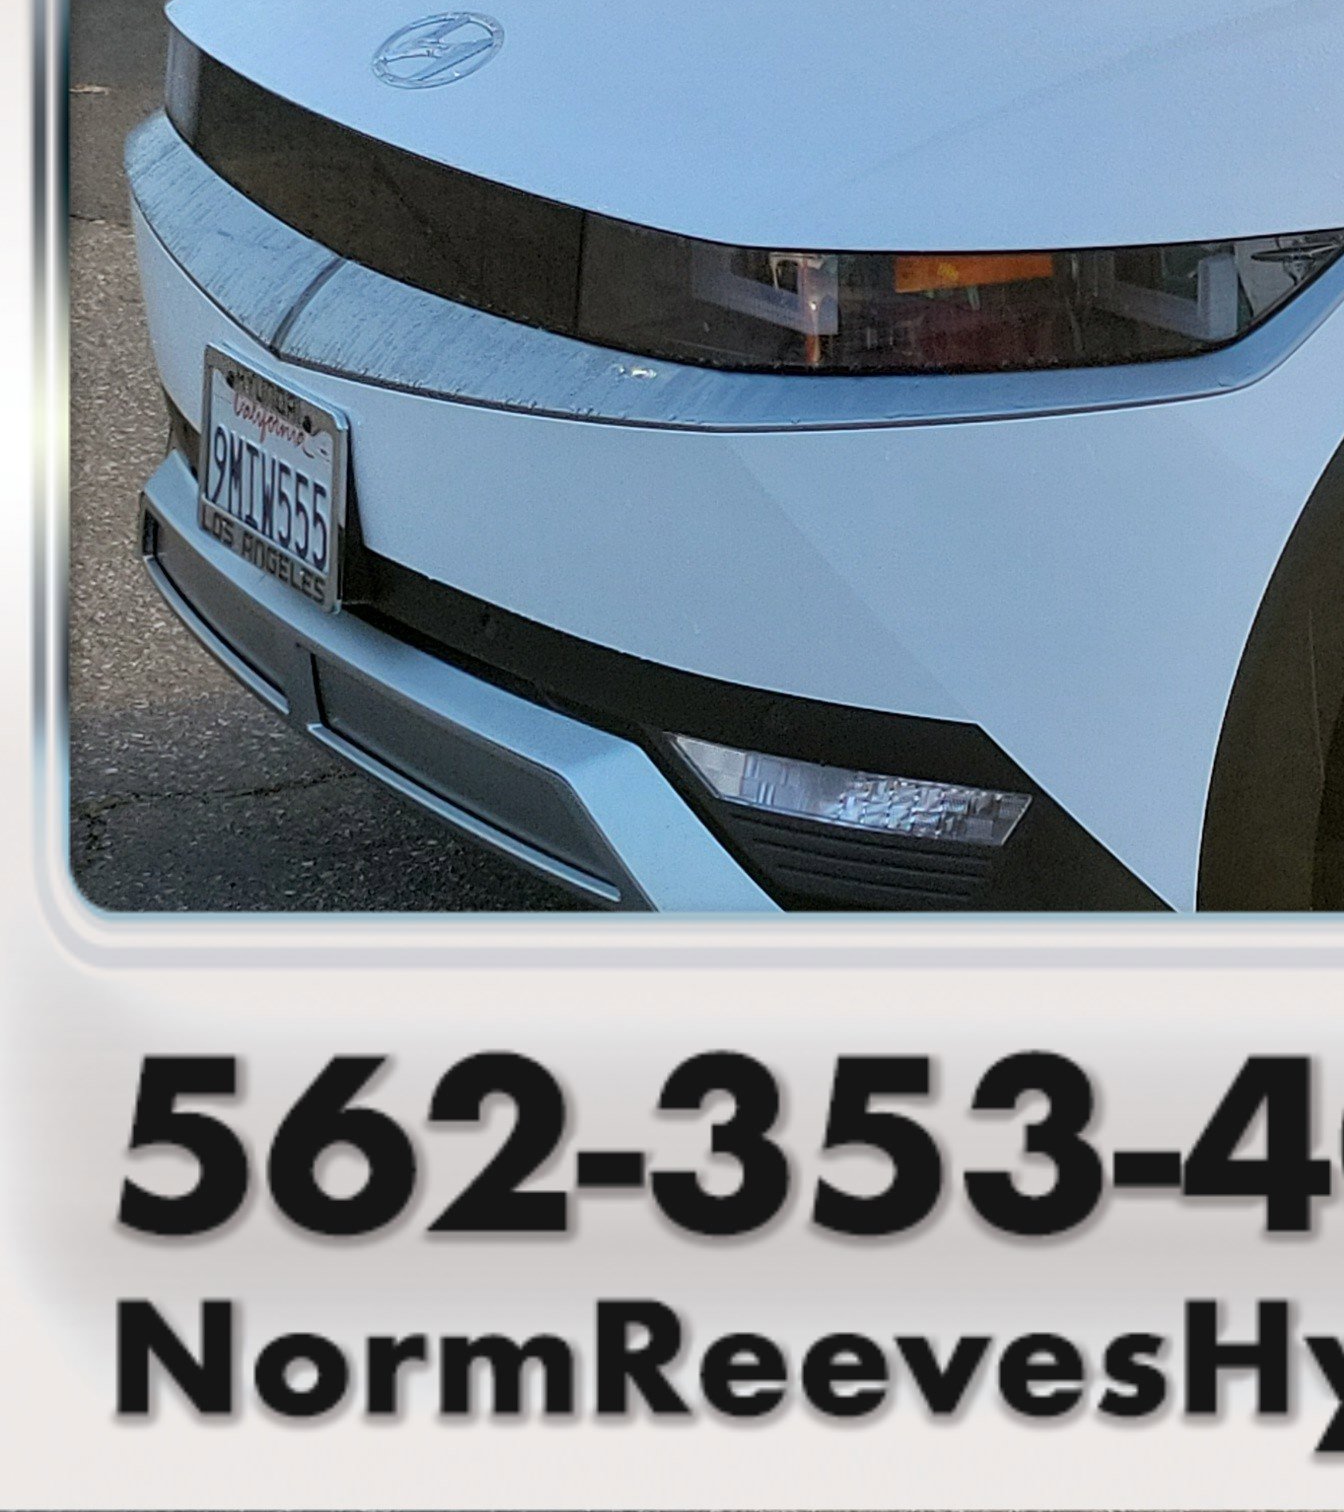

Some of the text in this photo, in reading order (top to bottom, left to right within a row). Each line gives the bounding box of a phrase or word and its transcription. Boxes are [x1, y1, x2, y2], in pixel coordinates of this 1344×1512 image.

[201, 508, 326, 604] LOS ANGELES
[213, 424, 328, 572] 9MIW555
